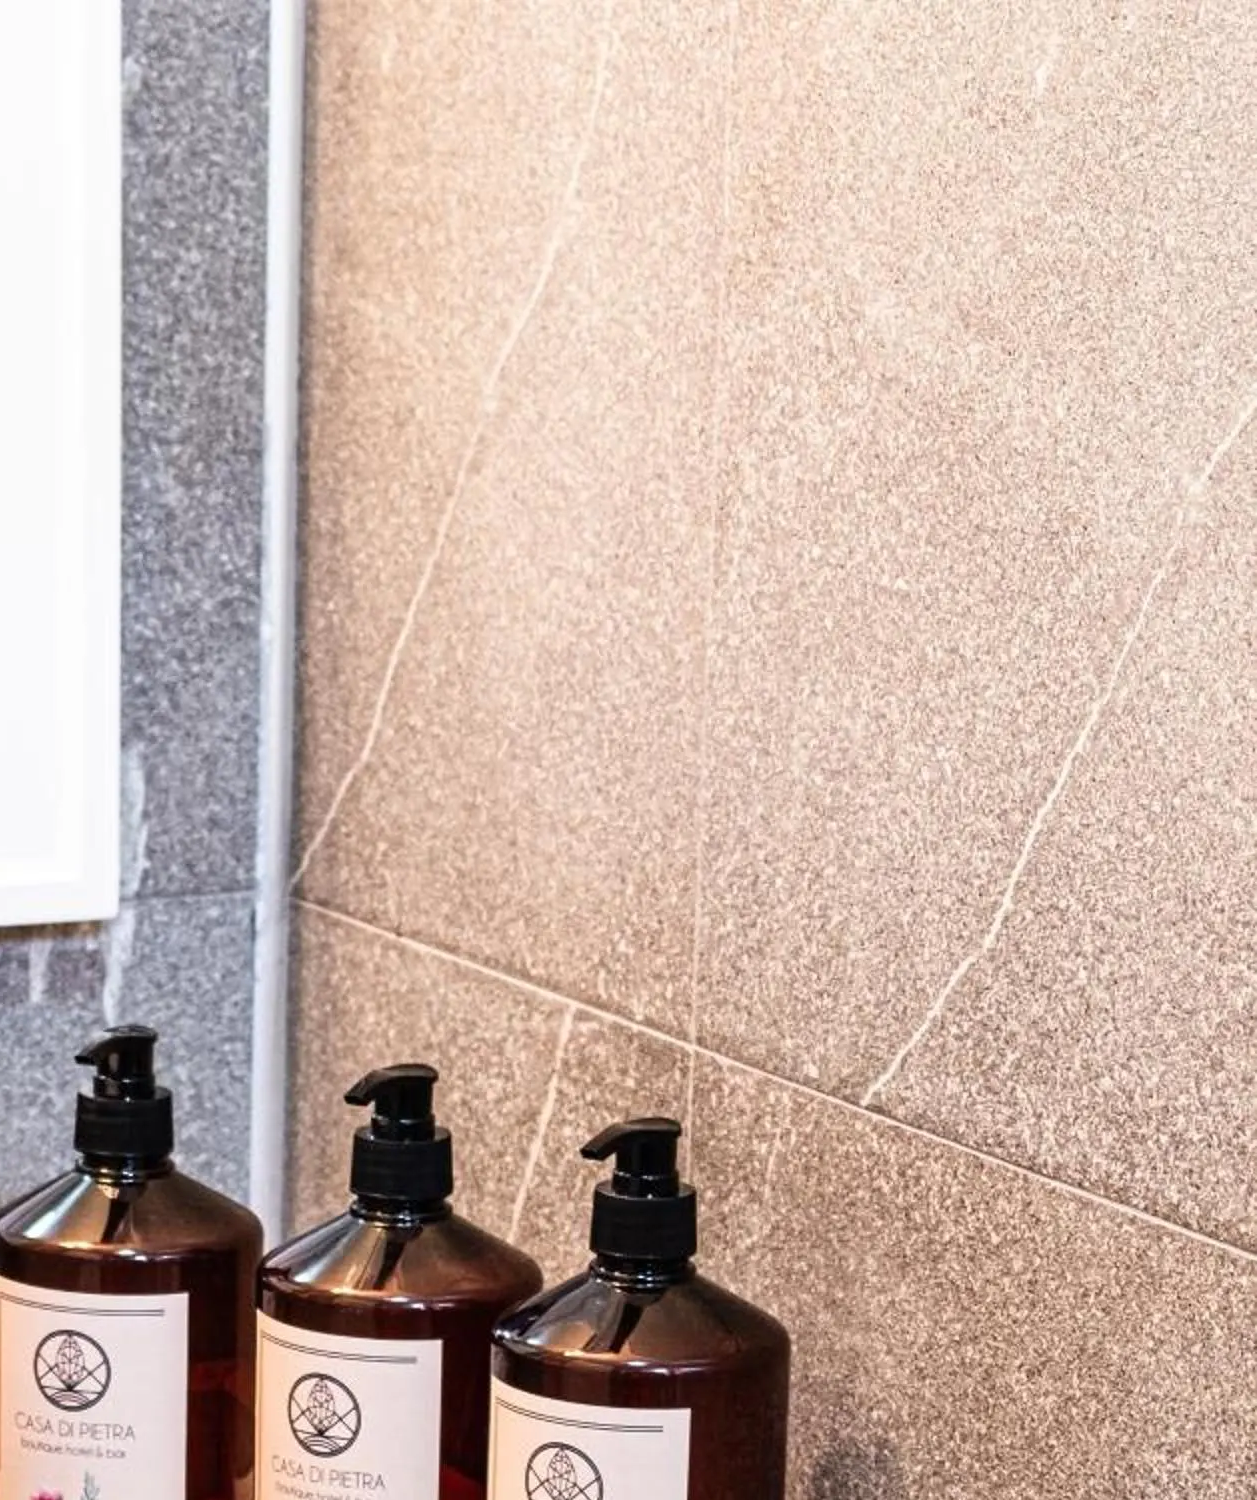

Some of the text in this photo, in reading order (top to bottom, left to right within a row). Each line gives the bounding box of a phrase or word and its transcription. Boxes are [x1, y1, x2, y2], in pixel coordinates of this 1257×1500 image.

[14, 1411, 136, 1441] CASA DI PIETRA
[271, 1454, 386, 1491] CASA DI PIETRA
